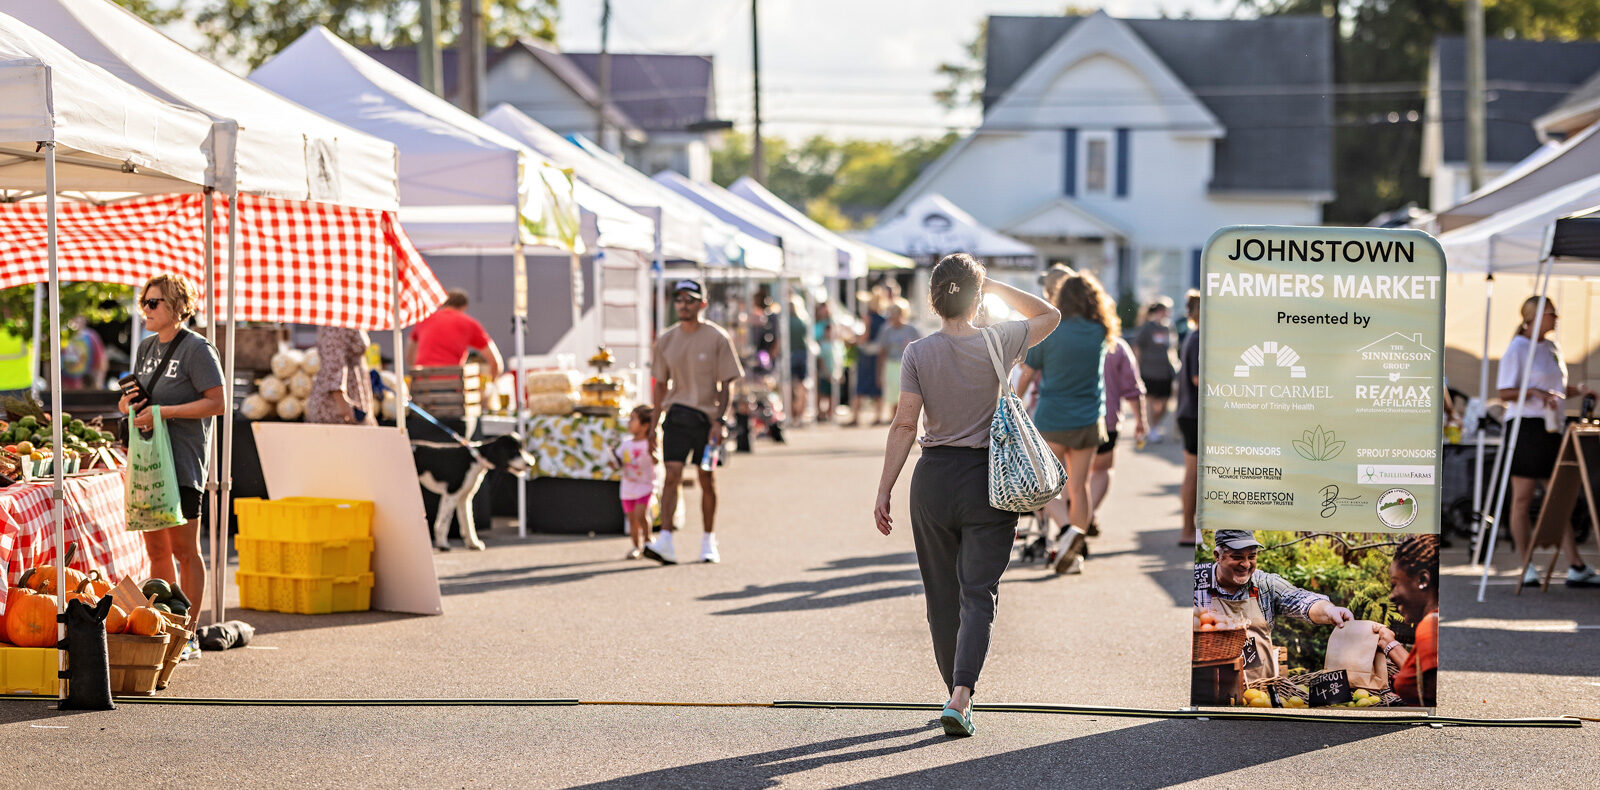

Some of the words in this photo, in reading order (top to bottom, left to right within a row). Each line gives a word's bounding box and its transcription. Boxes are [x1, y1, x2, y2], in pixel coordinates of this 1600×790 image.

[1228, 239, 1415, 263] JOHNSTOWN
[1206, 272, 1325, 298] FARMERS
[1333, 274, 1441, 300] MARKET
[1277, 311, 1349, 325] Presented
[1353, 312, 1371, 328] by
[1361, 351, 1432, 361] SINNINGSON
[1206, 383, 1267, 397] MOUNT
[1269, 384, 1335, 399] CARMEL
[1355, 384, 1431, 400] RE/MAX
[1223, 401, 1230, 409] A
[1230, 402, 1260, 410] Member
[1260, 402, 1268, 410] of
[1270, 402, 1291, 411] Trinity
[1292, 402, 1315, 411] Health
[1372, 398, 1432, 408] AFFILIATES
[1206, 445, 1234, 455] MUSIC
[1235, 446, 1282, 456] SPONSORS
[1356, 448, 1390, 458] SPROUT
[1391, 449, 1437, 459] SPONSORS
[1205, 466, 1231, 475] TROY
[1233, 467, 1282, 476] HENDREN
[1204, 491, 1230, 501] JOEY
[1232, 491, 1294, 501] ROBERTSON
